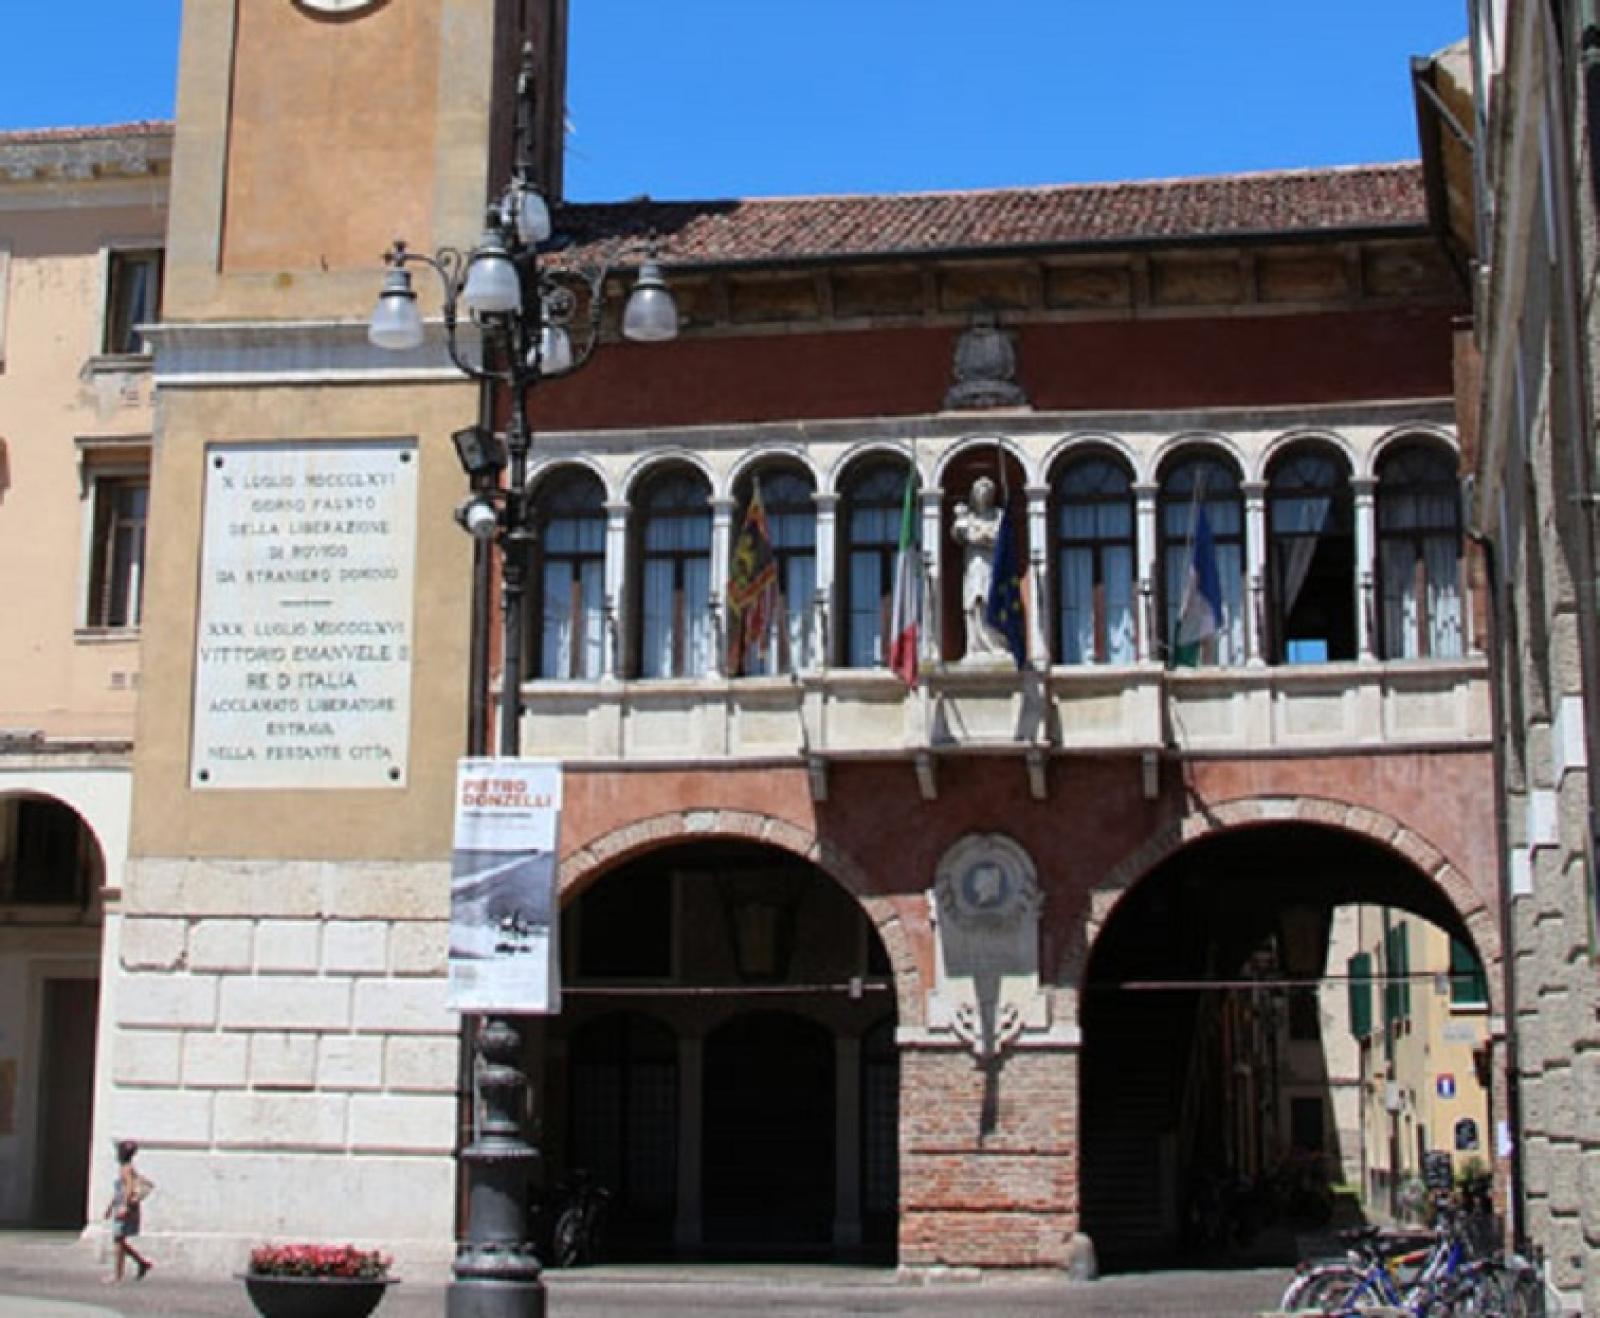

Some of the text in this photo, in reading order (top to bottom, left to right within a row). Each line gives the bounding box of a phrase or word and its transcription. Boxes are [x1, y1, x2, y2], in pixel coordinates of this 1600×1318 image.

[229, 520, 389, 535] DELLA LIBERAZIONE
[291, 544, 348, 559] ROVIGO
[216, 570, 236, 583] DA
[246, 569, 331, 583] STRANIERO
[201, 646, 286, 663] VITTORIO
[247, 672, 271, 689] RE
[208, 697, 396, 712] ACCLAMATO LIBERATORE
[208, 747, 256, 760] NELLA
[266, 746, 341, 760] FESTANTE
[463, 779, 528, 793] PIETRO
[462, 793, 551, 808] DONZELLI
